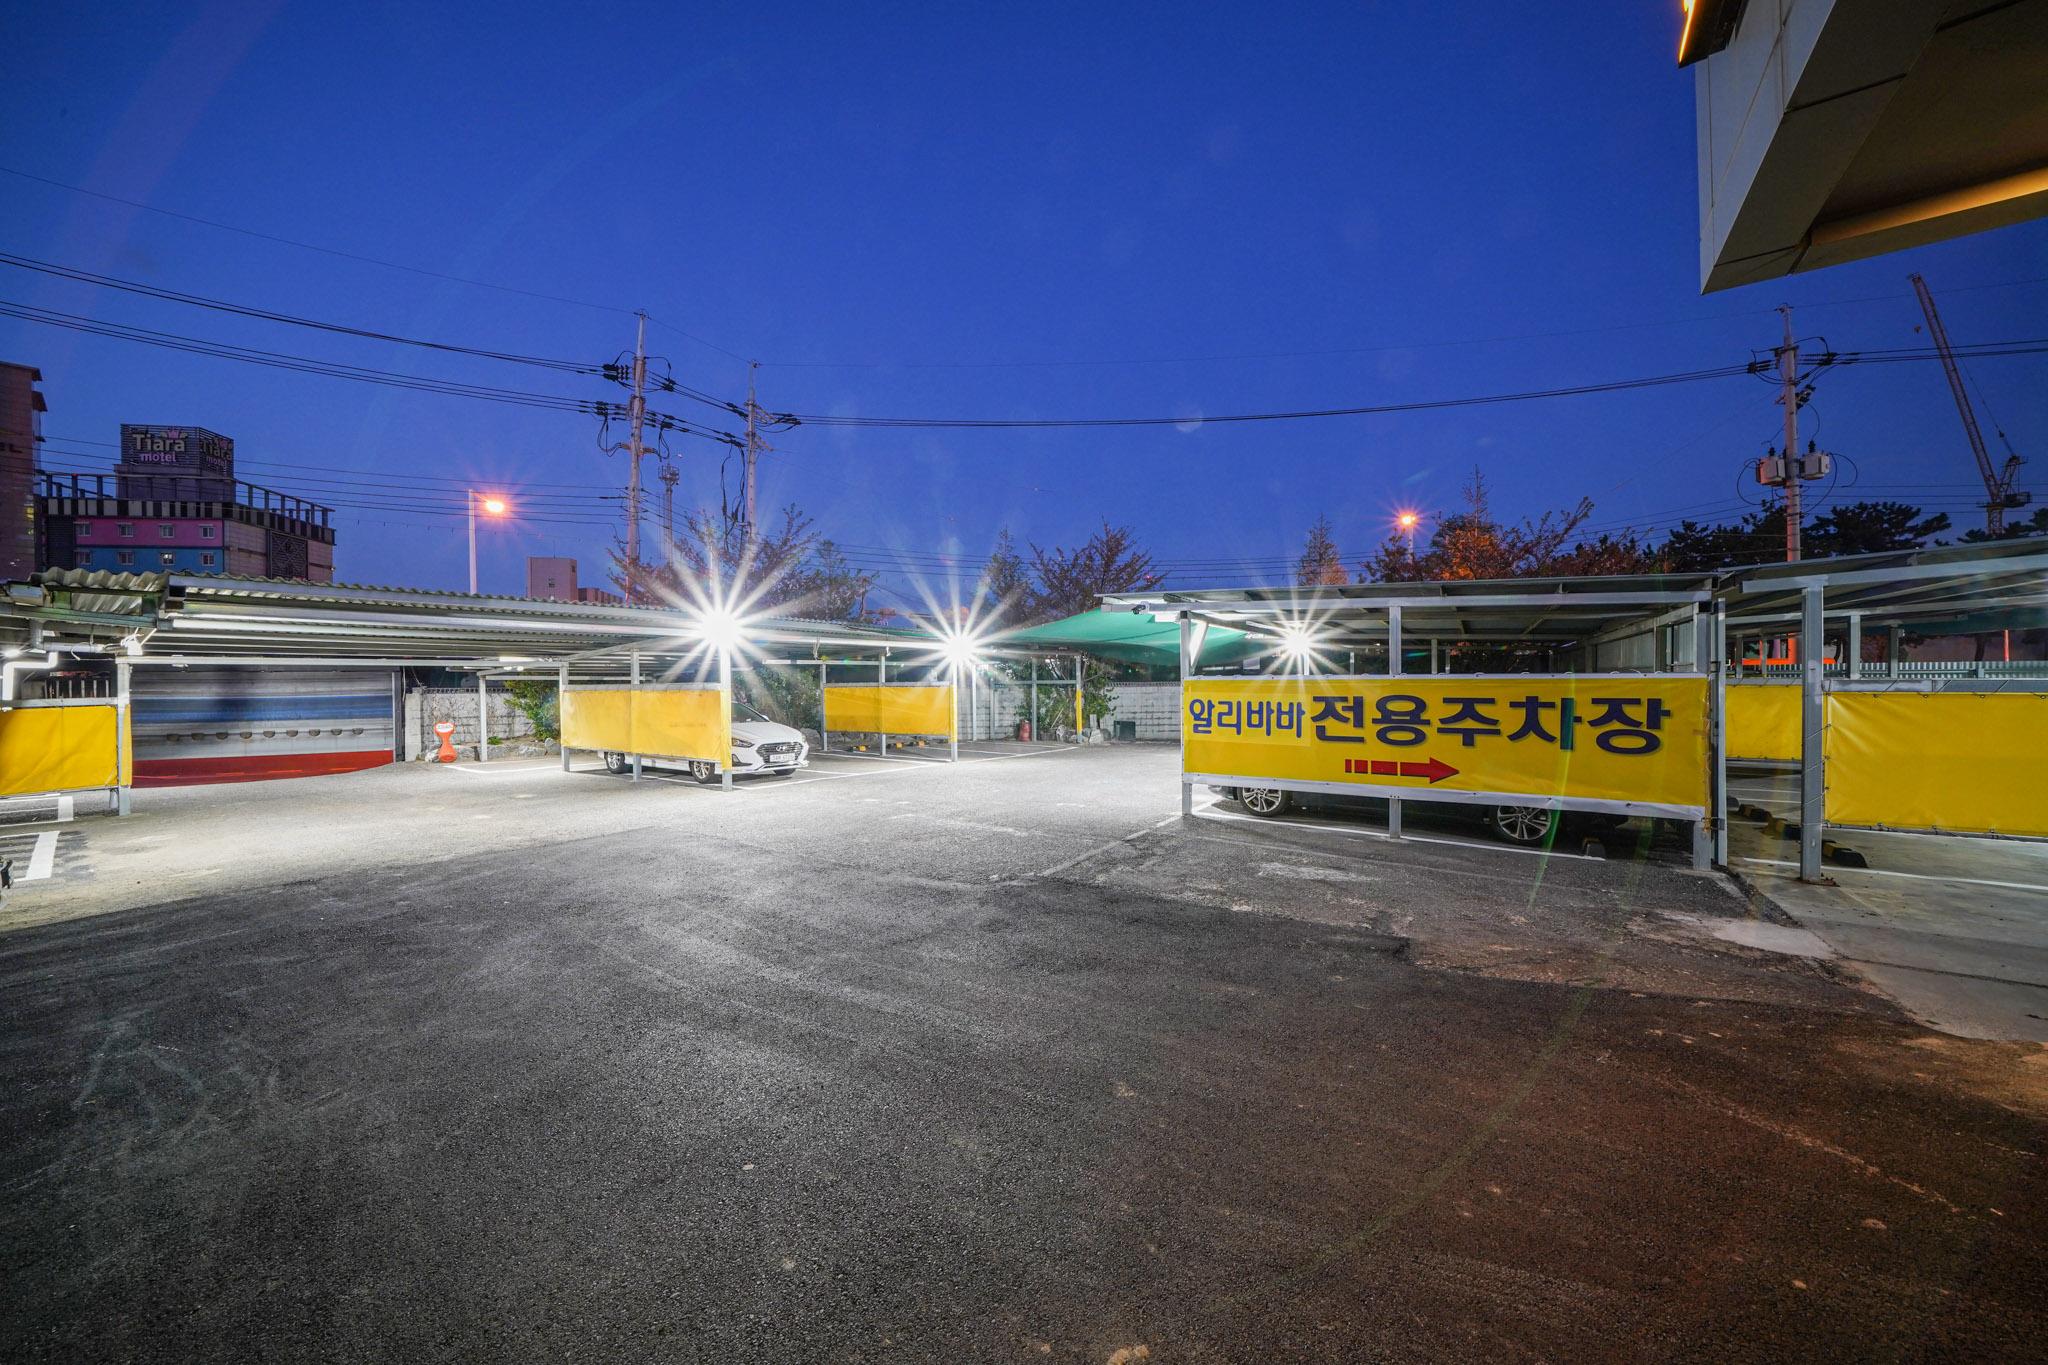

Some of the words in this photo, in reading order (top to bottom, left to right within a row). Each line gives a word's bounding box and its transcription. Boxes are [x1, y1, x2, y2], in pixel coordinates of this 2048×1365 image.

[132, 433, 186, 452] Tiara
[140, 451, 176, 462] motel
[1189, 698, 1306, 738] 알리바바
[1310, 694, 1671, 755] 전용주차장
